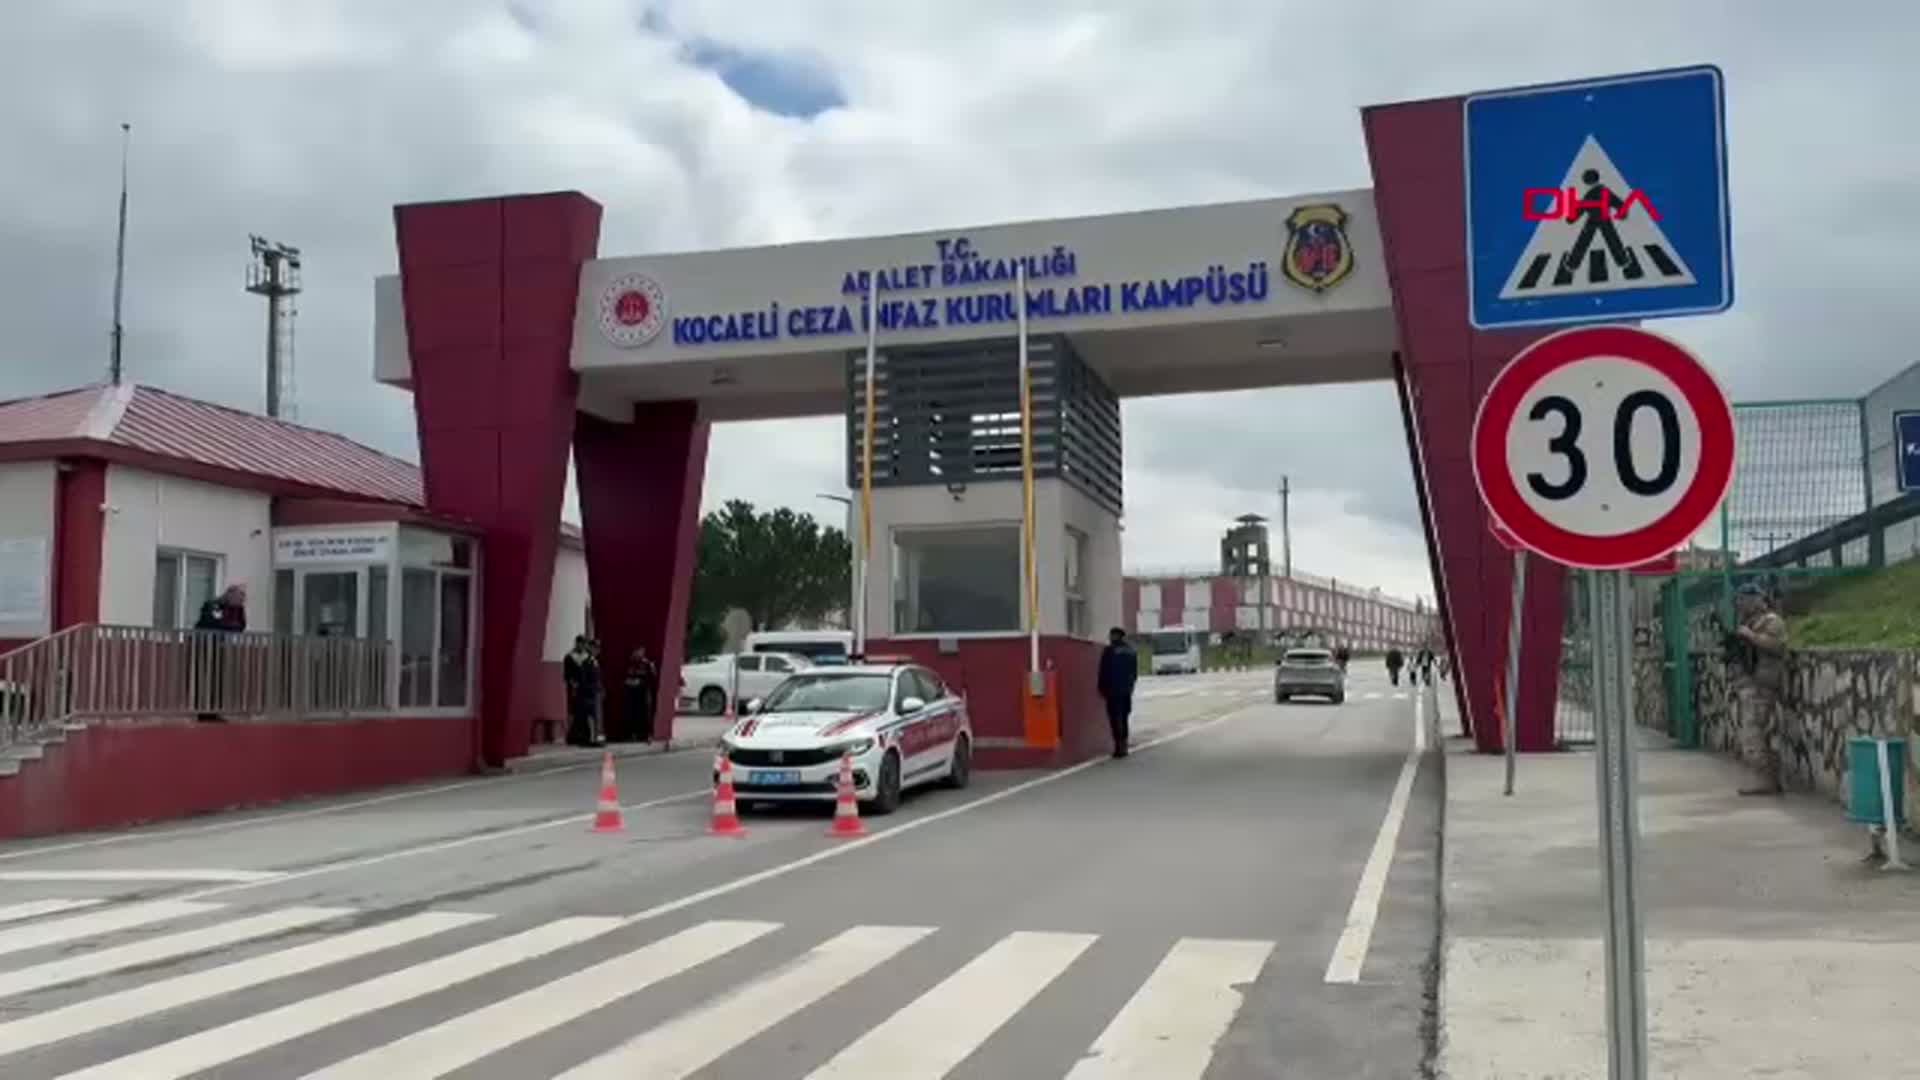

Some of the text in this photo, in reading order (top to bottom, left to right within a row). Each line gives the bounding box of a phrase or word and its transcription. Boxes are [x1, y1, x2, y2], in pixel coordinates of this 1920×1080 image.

[936, 238, 978, 260] T.C.
[673, 301, 778, 345] KOCAELİ
[787, 306, 854, 337] CEZA
[1121, 262, 1268, 312] KAMPÜSÜ
[841, 265, 934, 294] ADALET
[1526, 389, 1681, 500] 30
